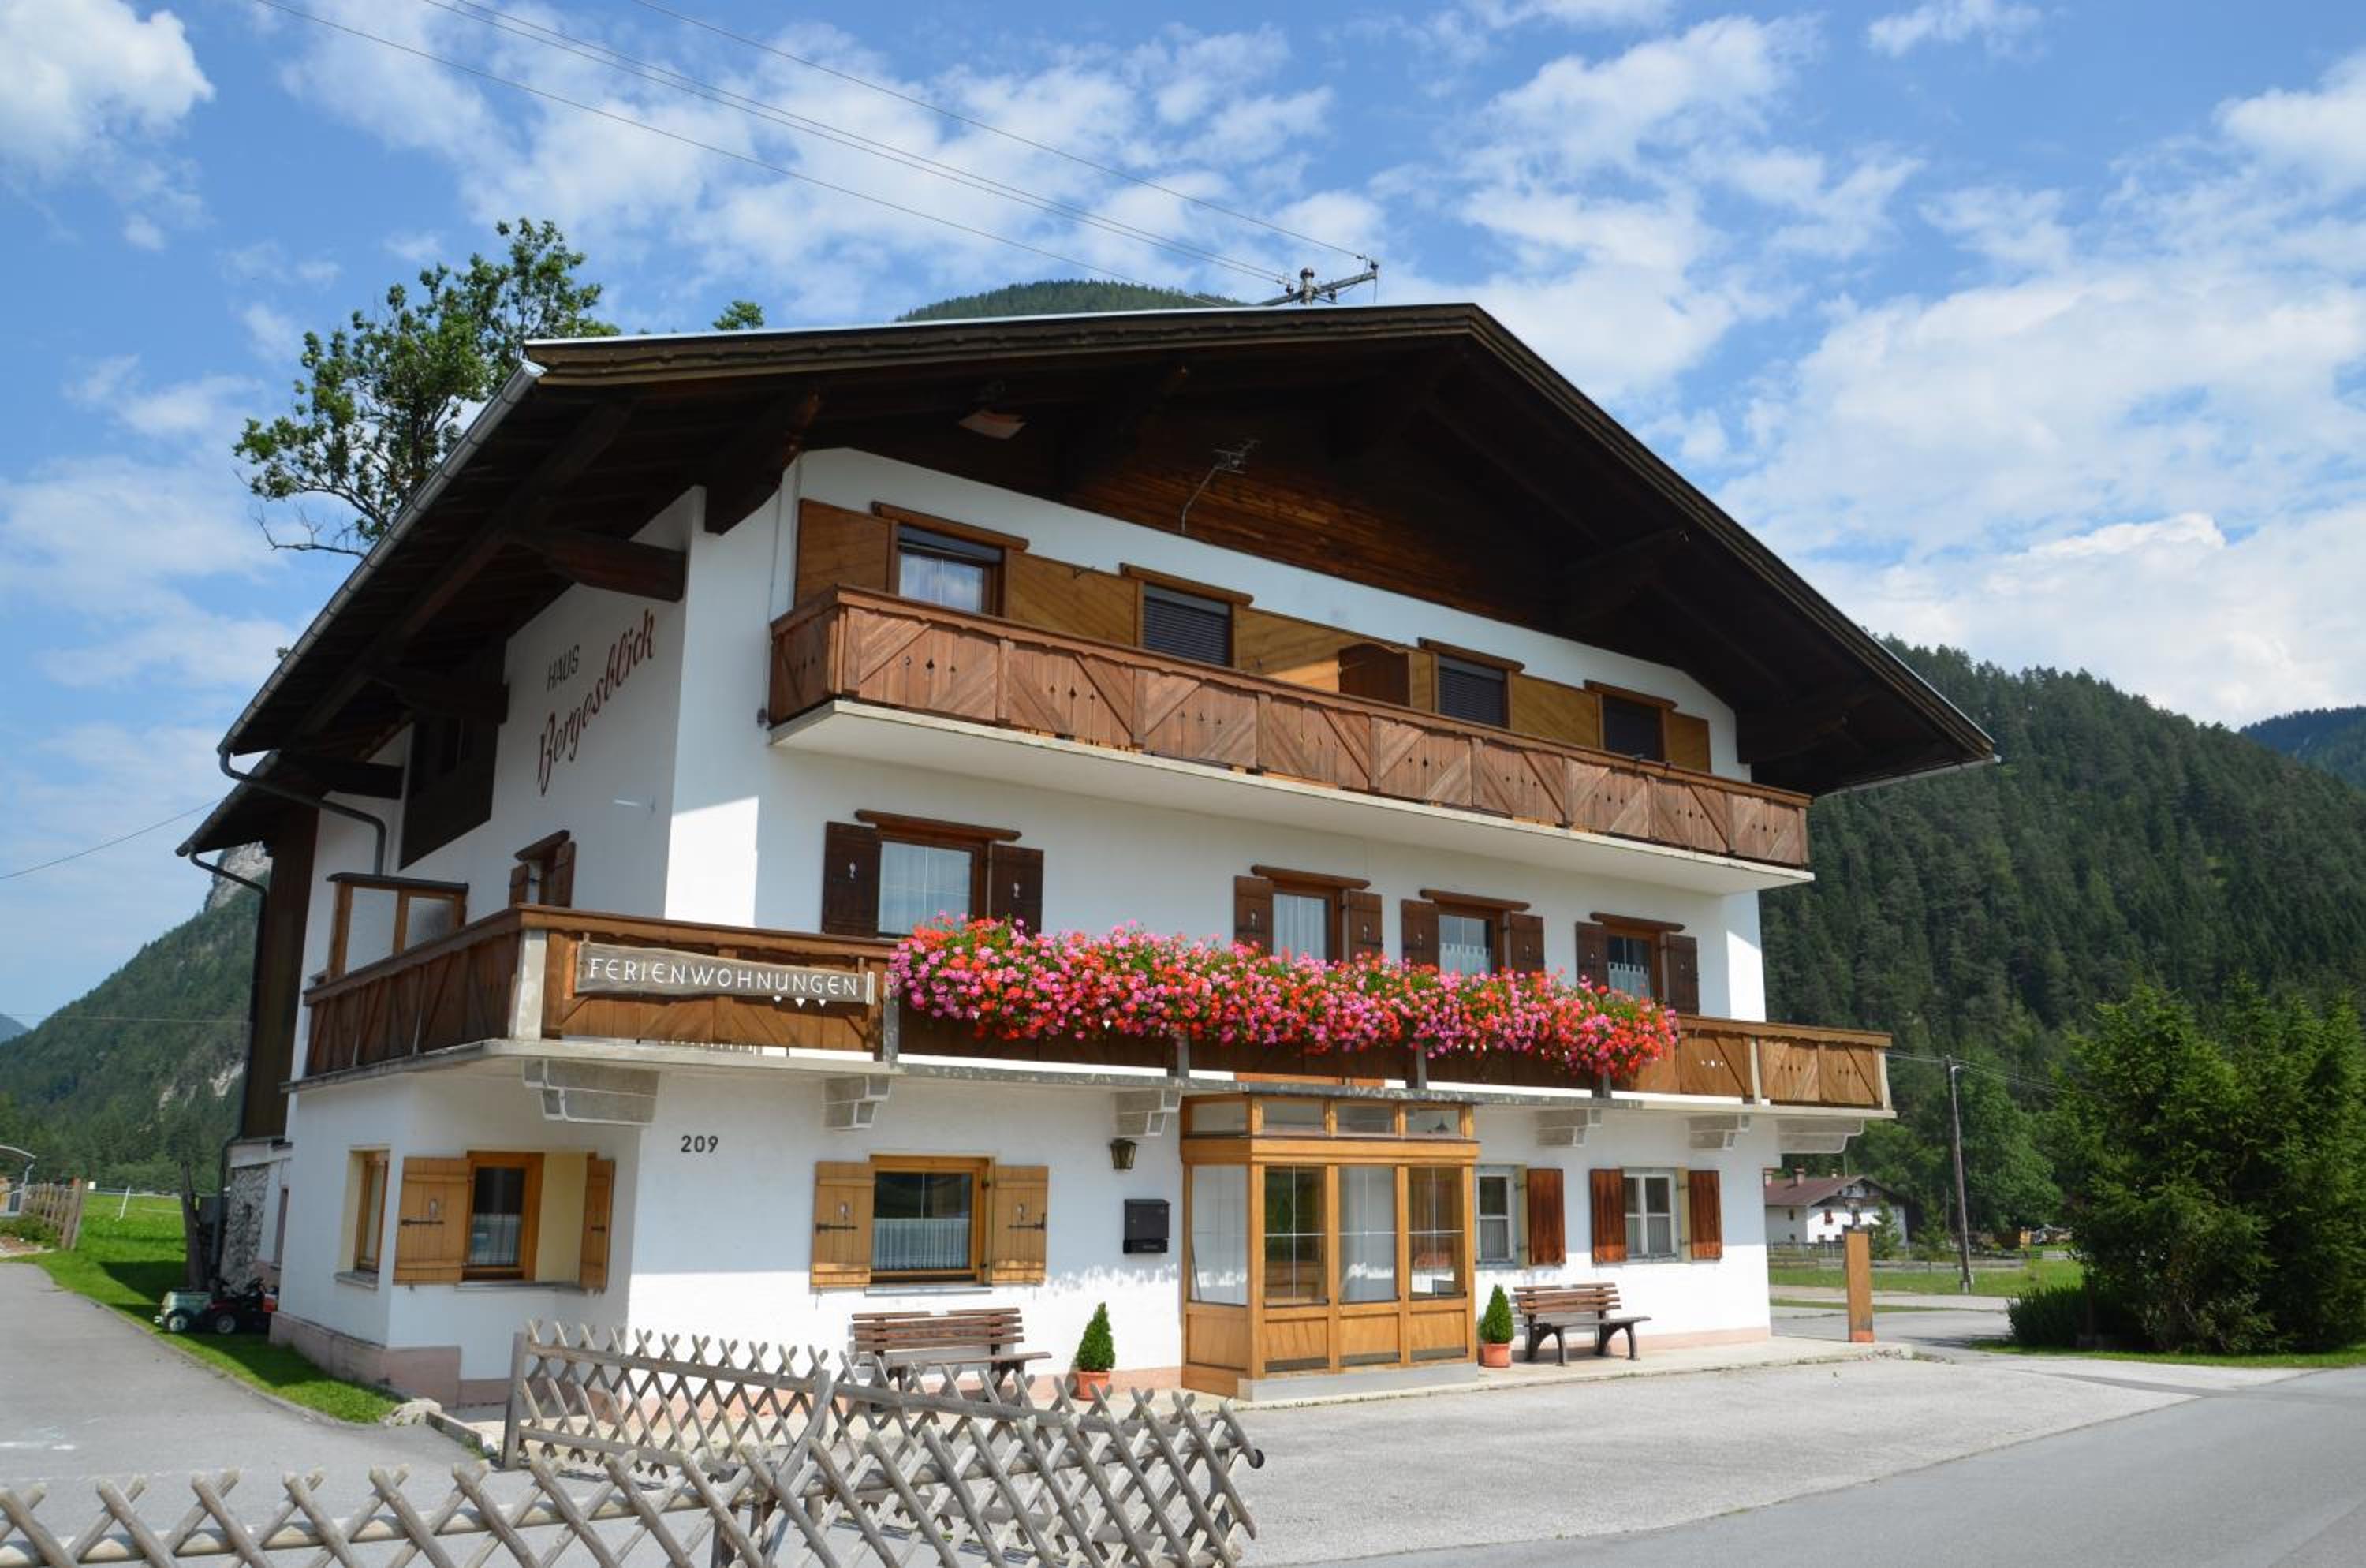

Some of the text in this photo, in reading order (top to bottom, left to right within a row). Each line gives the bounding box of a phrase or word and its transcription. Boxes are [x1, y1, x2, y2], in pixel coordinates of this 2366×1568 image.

[547, 644, 580, 692] HAUS
[537, 607, 655, 796] Bergesblick
[588, 957, 859, 997] FERIENWOHNUNGEN
[681, 1135, 719, 1154] 209
